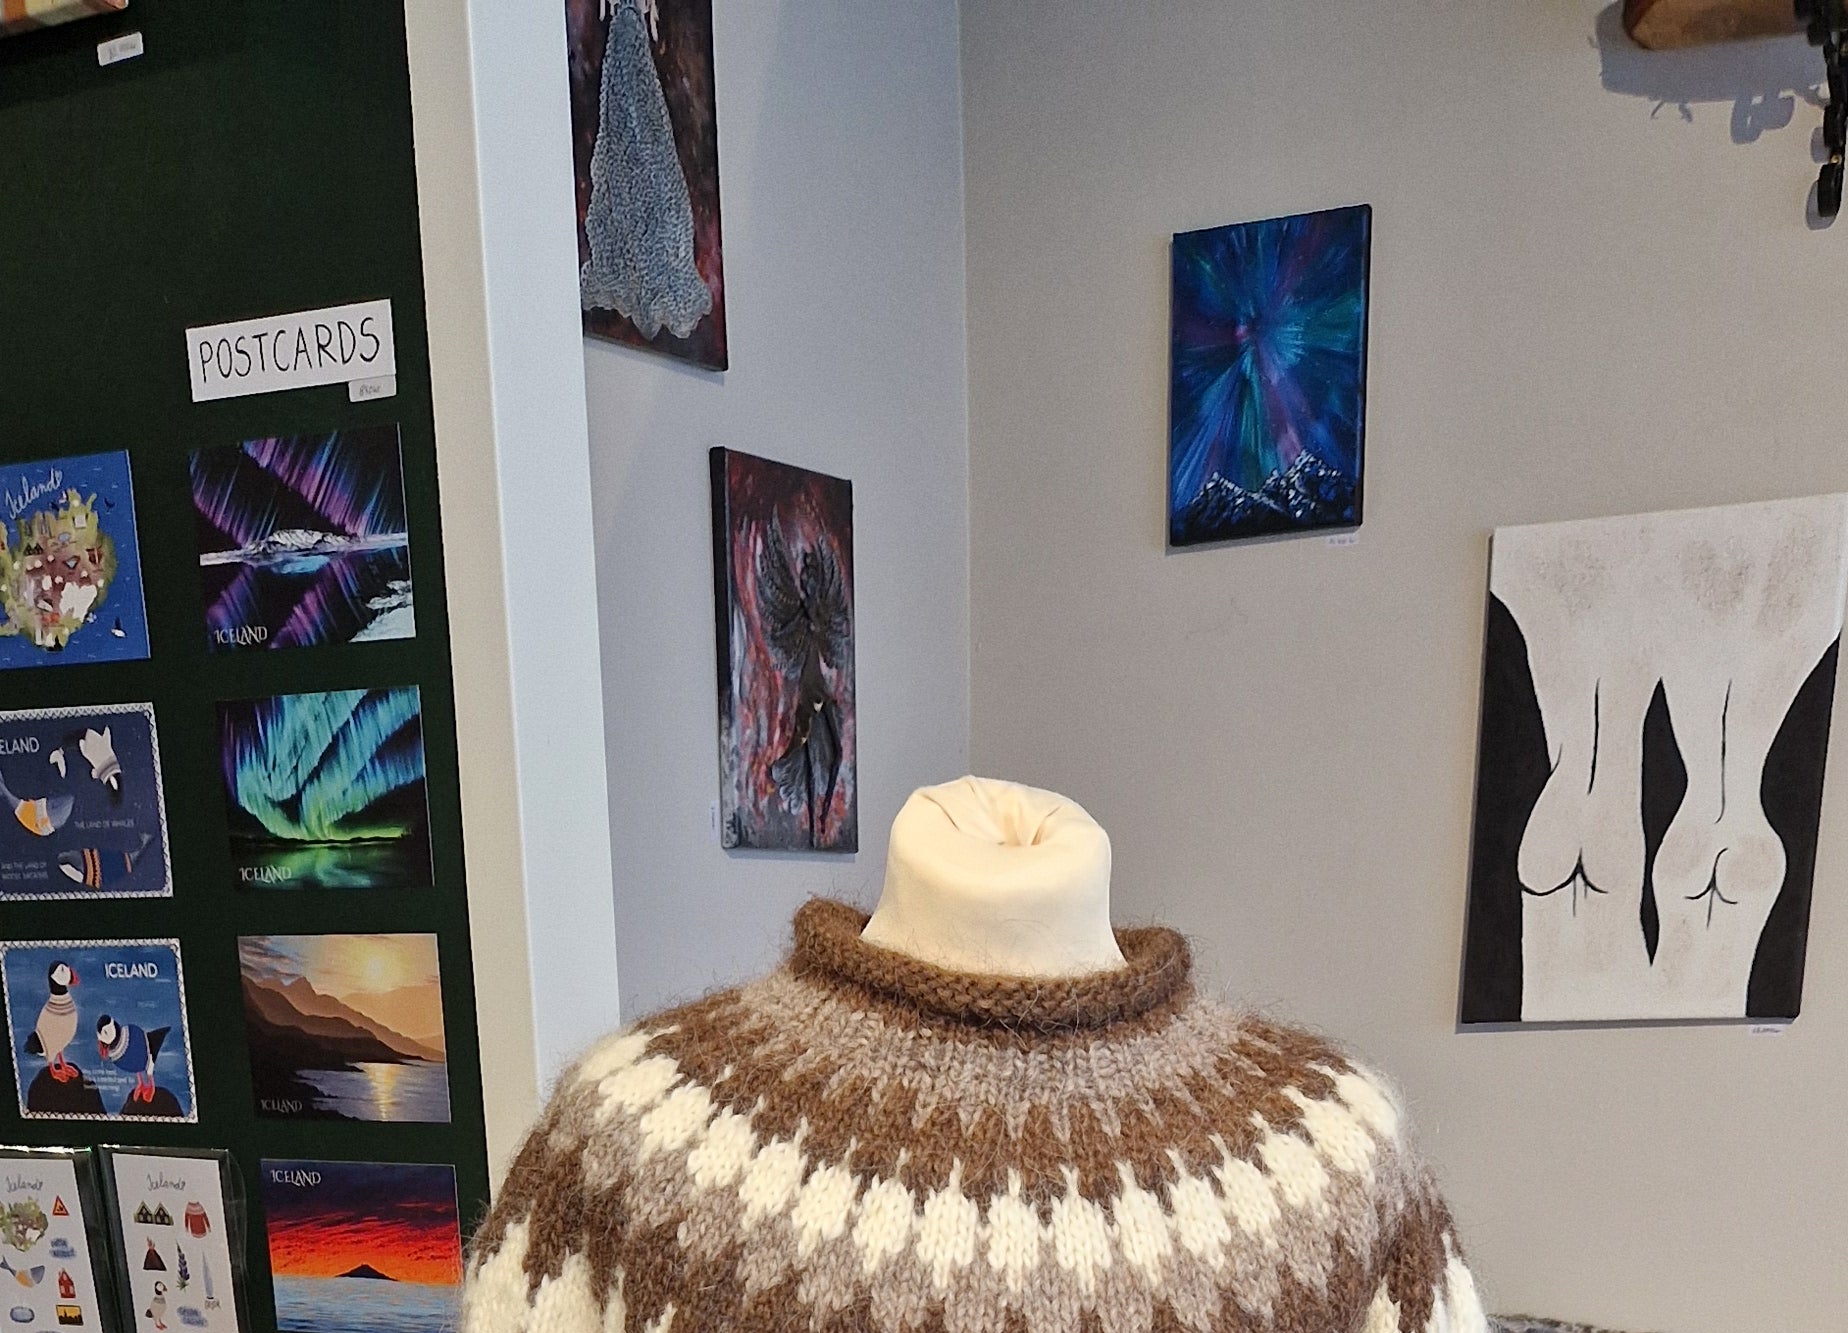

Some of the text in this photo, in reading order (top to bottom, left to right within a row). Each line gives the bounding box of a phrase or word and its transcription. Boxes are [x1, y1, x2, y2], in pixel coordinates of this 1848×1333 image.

[199, 316, 380, 383] POSTCARDS
[213, 624, 268, 646] ICELAND
[238, 864, 292, 885] ICELAND
[104, 962, 158, 979] ICELAND
[260, 1098, 303, 1113] ICELAND
[270, 1168, 322, 1187] ICELAND
